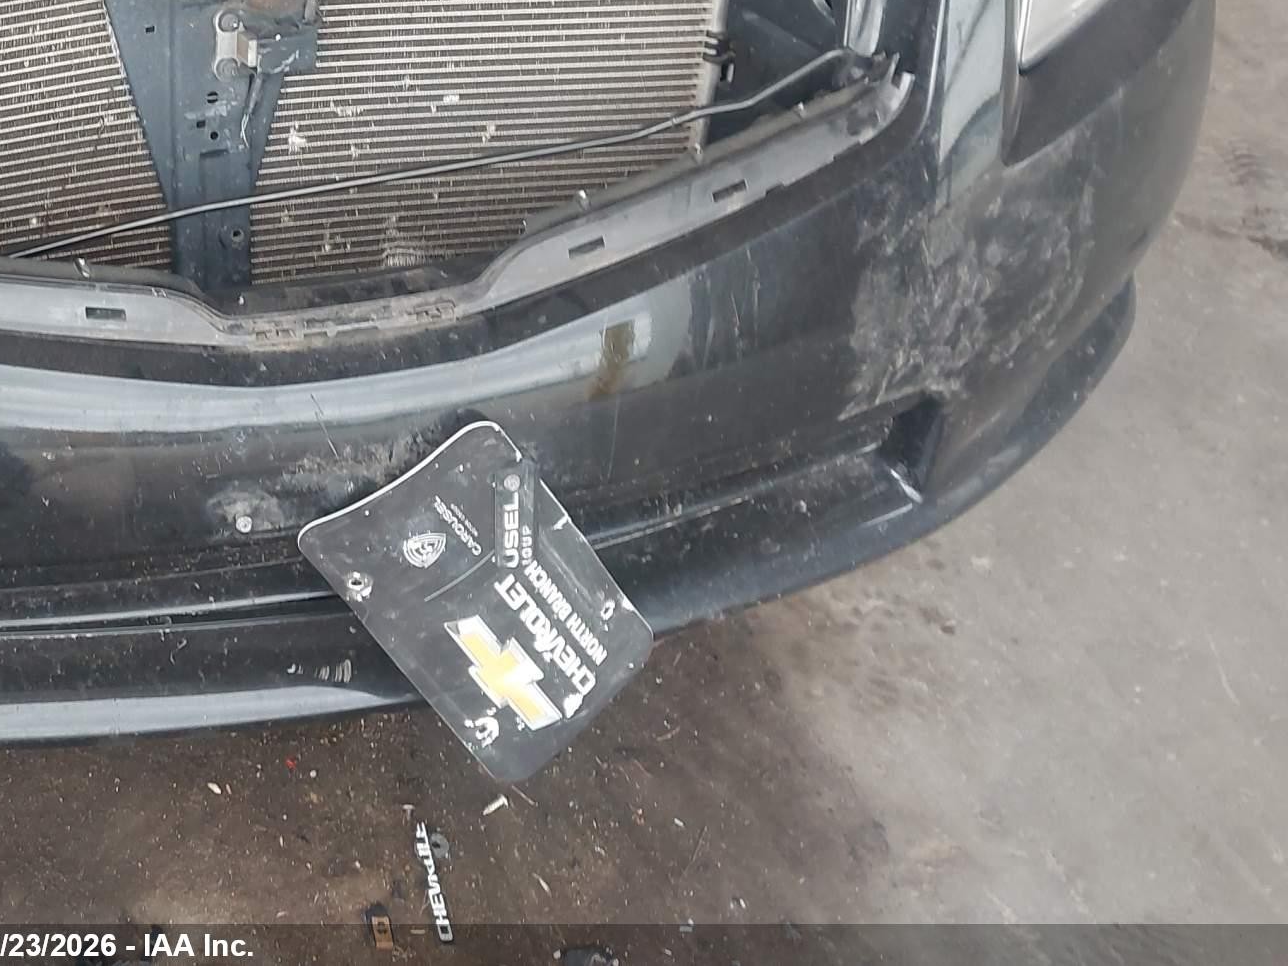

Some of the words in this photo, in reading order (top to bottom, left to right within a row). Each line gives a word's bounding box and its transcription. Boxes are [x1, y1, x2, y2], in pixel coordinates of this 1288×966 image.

[433, 495, 482, 556] CAROUSEL
[523, 560, 575, 624] BRANCH
[494, 573, 596, 696] CHEVROLET
[565, 612, 608, 666] NORTH
